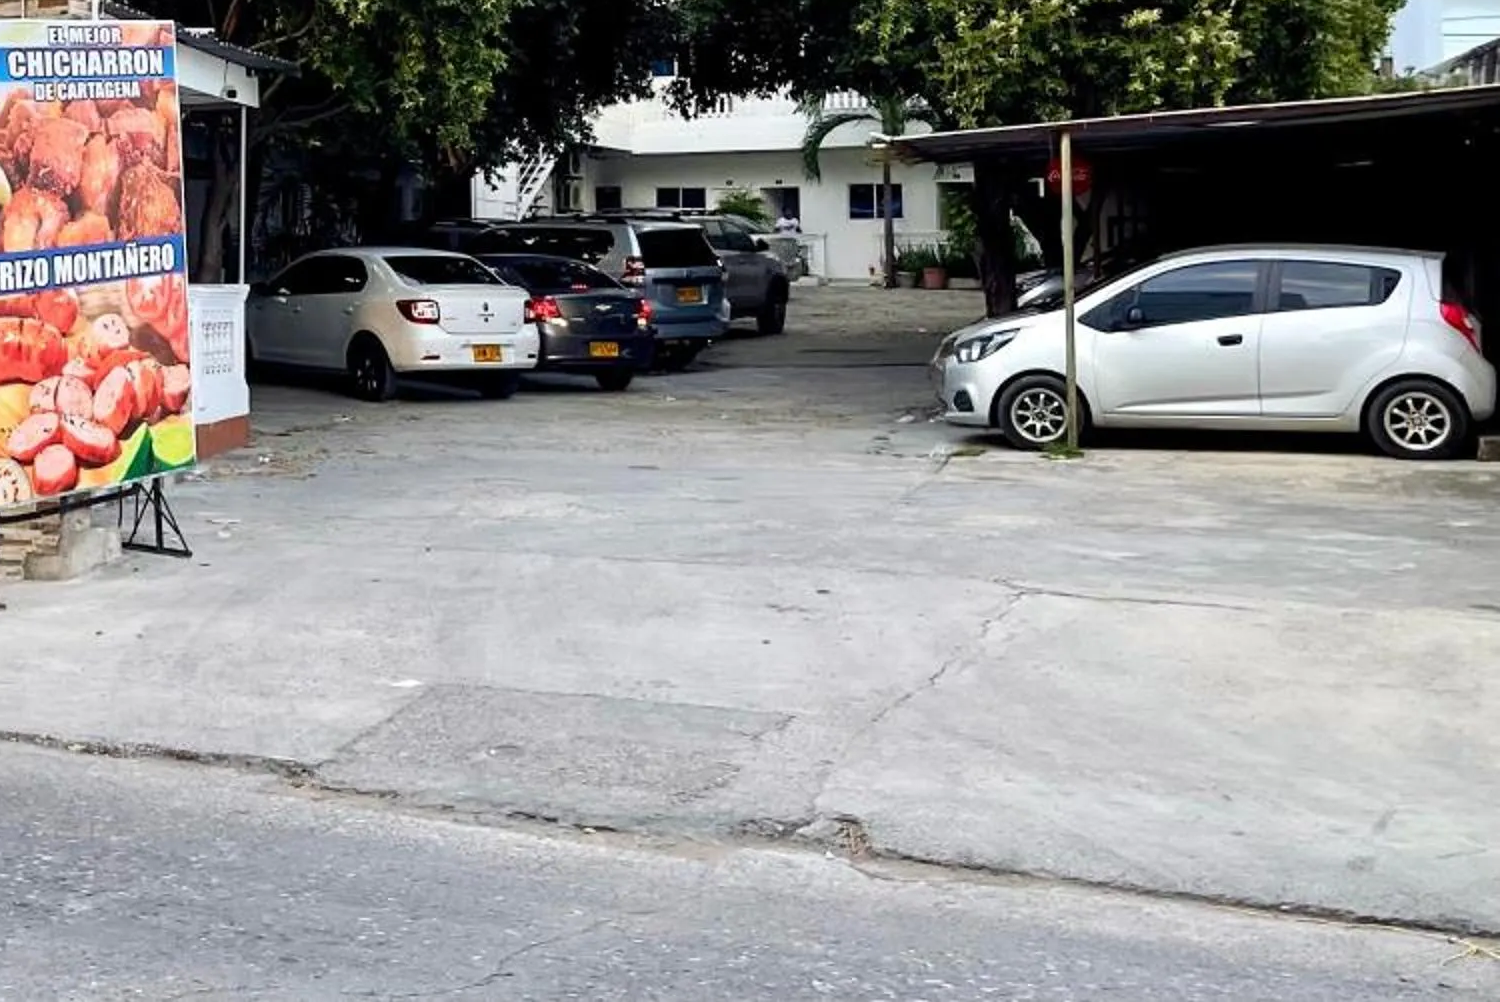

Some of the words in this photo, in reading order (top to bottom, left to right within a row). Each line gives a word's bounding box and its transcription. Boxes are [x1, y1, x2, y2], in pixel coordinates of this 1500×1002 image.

[48, 26, 66, 44] EL
[69, 27, 122, 45] MEJOR
[7, 49, 165, 78] CHICHARRON
[34, 82, 55, 101] DE
[58, 80, 141, 100] CARTAGENA
[54, 242, 175, 286] MONTAÑERO
